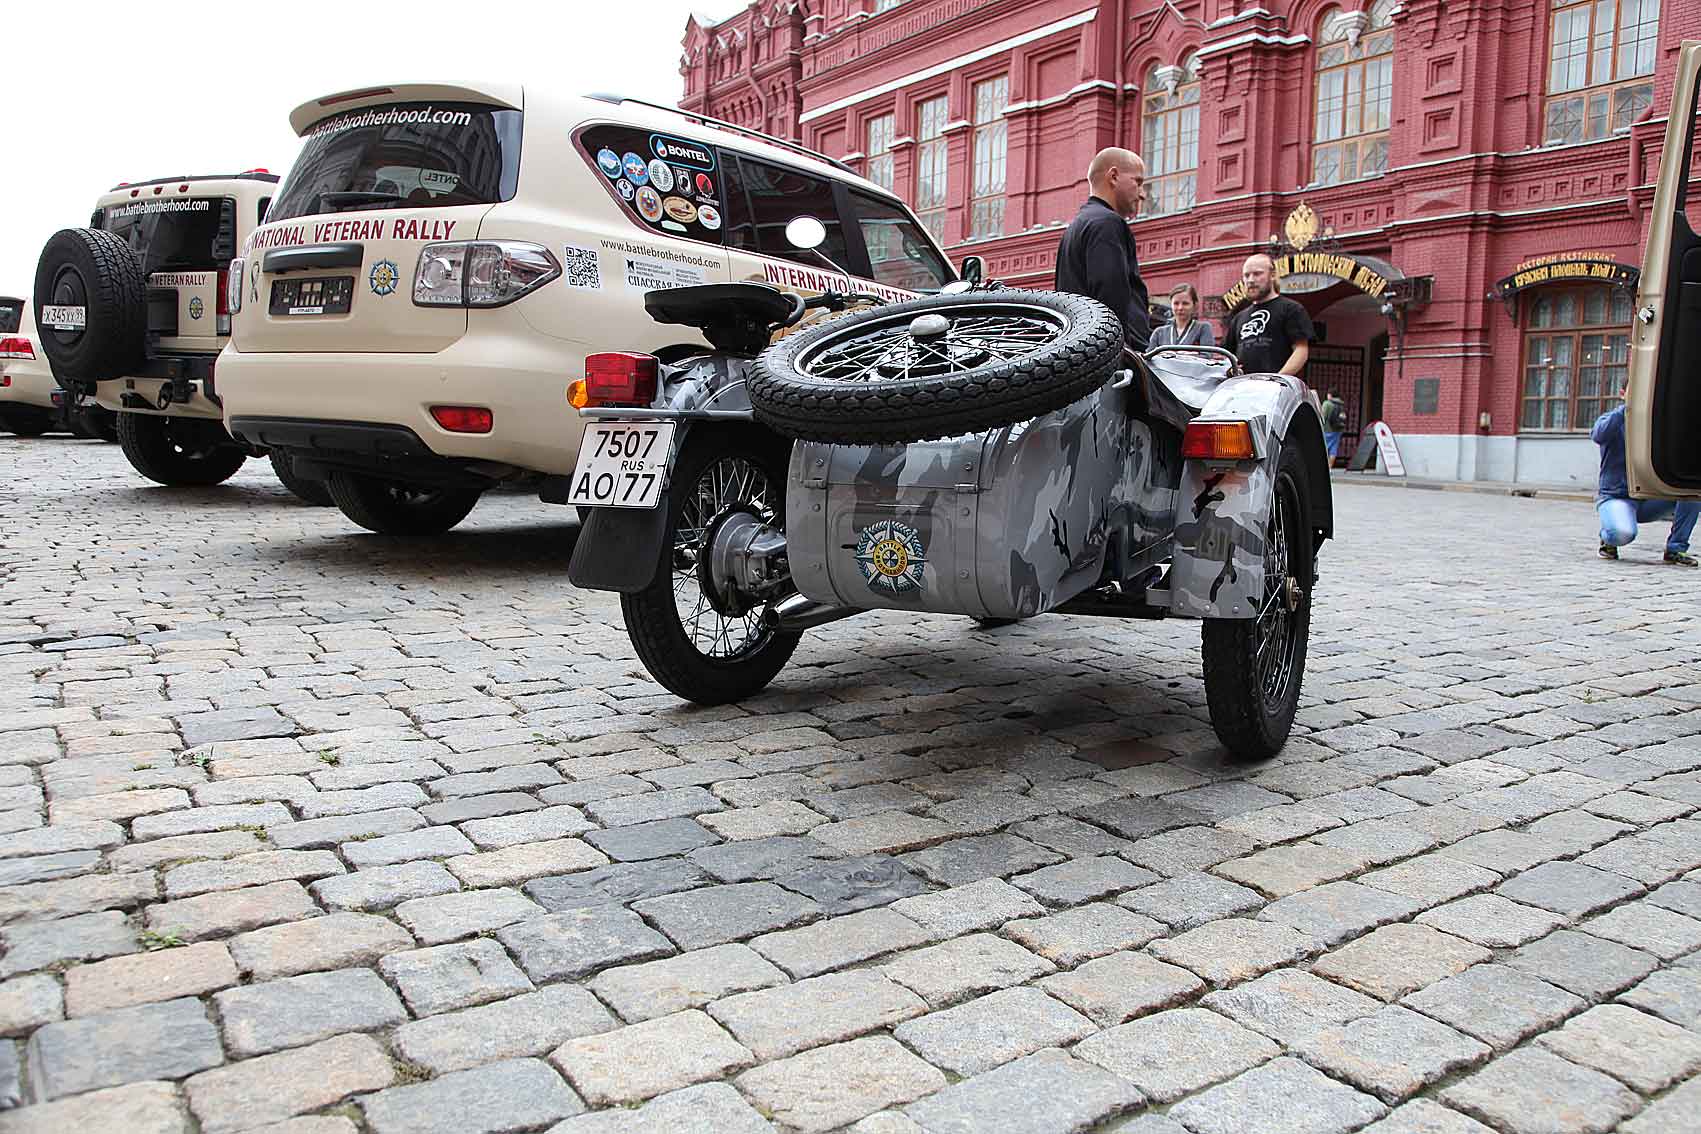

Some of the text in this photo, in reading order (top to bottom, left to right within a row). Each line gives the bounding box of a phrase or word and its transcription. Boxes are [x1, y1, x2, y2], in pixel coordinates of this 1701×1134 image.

[667, 144, 710, 163] BONTEL
[110, 199, 209, 218] www.battlebrotherhood.com
[313, 219, 385, 243] VETERAN
[392, 218, 456, 240] RALLY
[600, 239, 721, 269] www.battlebrotherhood.com
[155, 274, 207, 286] VETERAN RALLY
[628, 275, 672, 290] СПАССКАЯ
[594, 430, 659, 459] 7507
[620, 460, 645, 471] RUS
[622, 473, 656, 502] 77
[879, 542, 902, 553] BATTLE
